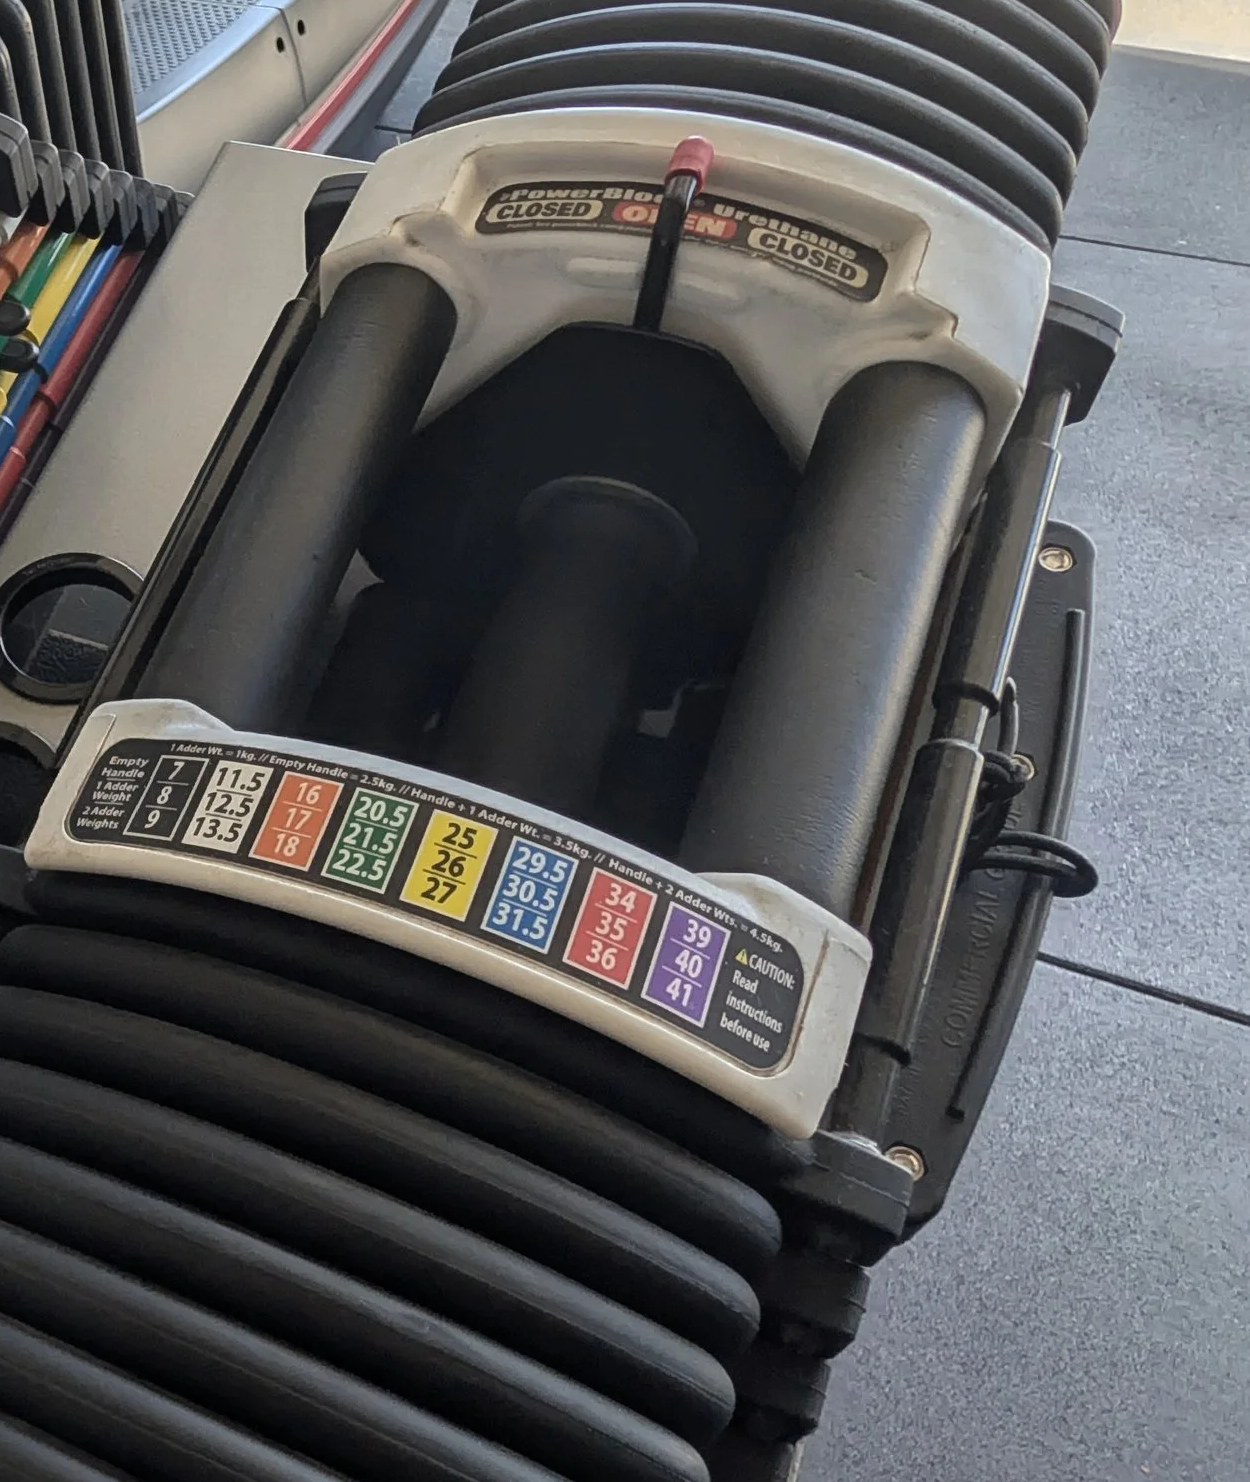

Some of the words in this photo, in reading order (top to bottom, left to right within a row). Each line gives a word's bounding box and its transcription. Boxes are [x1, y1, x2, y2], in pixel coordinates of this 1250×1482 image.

[497, 202, 592, 220] CLOSED
[713, 203, 857, 260] Urethane
[759, 232, 857, 281] CLOSED
[101, 767, 145, 778] Handle
[109, 756, 149, 768] Empty
[168, 761, 185, 780] 7
[96, 781, 102, 790] 1
[104, 781, 139, 792] Adder
[216, 767, 265, 792] 11.5
[296, 782, 322, 805] 16
[92, 791, 131, 803] Weight
[156, 786, 172, 805] 8
[205, 792, 254, 817] 12.5
[76, 818, 119, 830] Weights
[82, 806, 91, 815] 2
[91, 807, 125, 817] Adder
[144, 810, 160, 829] 9
[285, 808, 312, 830] 17
[354, 796, 409, 828] 20.5
[193, 817, 243, 842] 13.5
[343, 822, 398, 854] 21.5
[442, 822, 477, 850] 25
[176, 744, 207, 754] Adder
[208, 746, 223, 756] Wt.
[236, 750, 256, 762] 1kg.
[269, 755, 305, 770] Empty
[306, 762, 348, 779] Handle
[360, 774, 397, 791] 2.5kg.
[411, 788, 456, 809] Handle
[478, 809, 518, 830] Adder
[520, 823, 541, 839] Wt.
[554, 836, 591, 859] 3.5kg.
[608, 858, 653, 885] Handle
[665, 884, 674, 895] 2
[675, 889, 711, 914] Adder
[713, 907, 738, 928] Wts.
[750, 928, 783, 953] 4.5kg.
[274, 833, 300, 857] 18
[332, 849, 387, 881] 22.5
[431, 850, 467, 877] 26
[512, 846, 569, 883] 29.5
[420, 877, 457, 904] 27
[502, 874, 558, 911] 30.5
[605, 882, 637, 913] 34
[492, 902, 549, 940] 31.5
[595, 911, 628, 941] 35
[683, 919, 711, 948] 39
[585, 939, 618, 970] 36
[675, 949, 703, 978] 40
[733, 970, 759, 994] Read
[749, 954, 796, 991] CAUTION:
[940, 889, 1000, 1049] COMMERCIAL
[666, 978, 693, 1007] 41
[726, 991, 783, 1034] instructions
[720, 1013, 751, 1041] before
[752, 1035, 770, 1052] use
